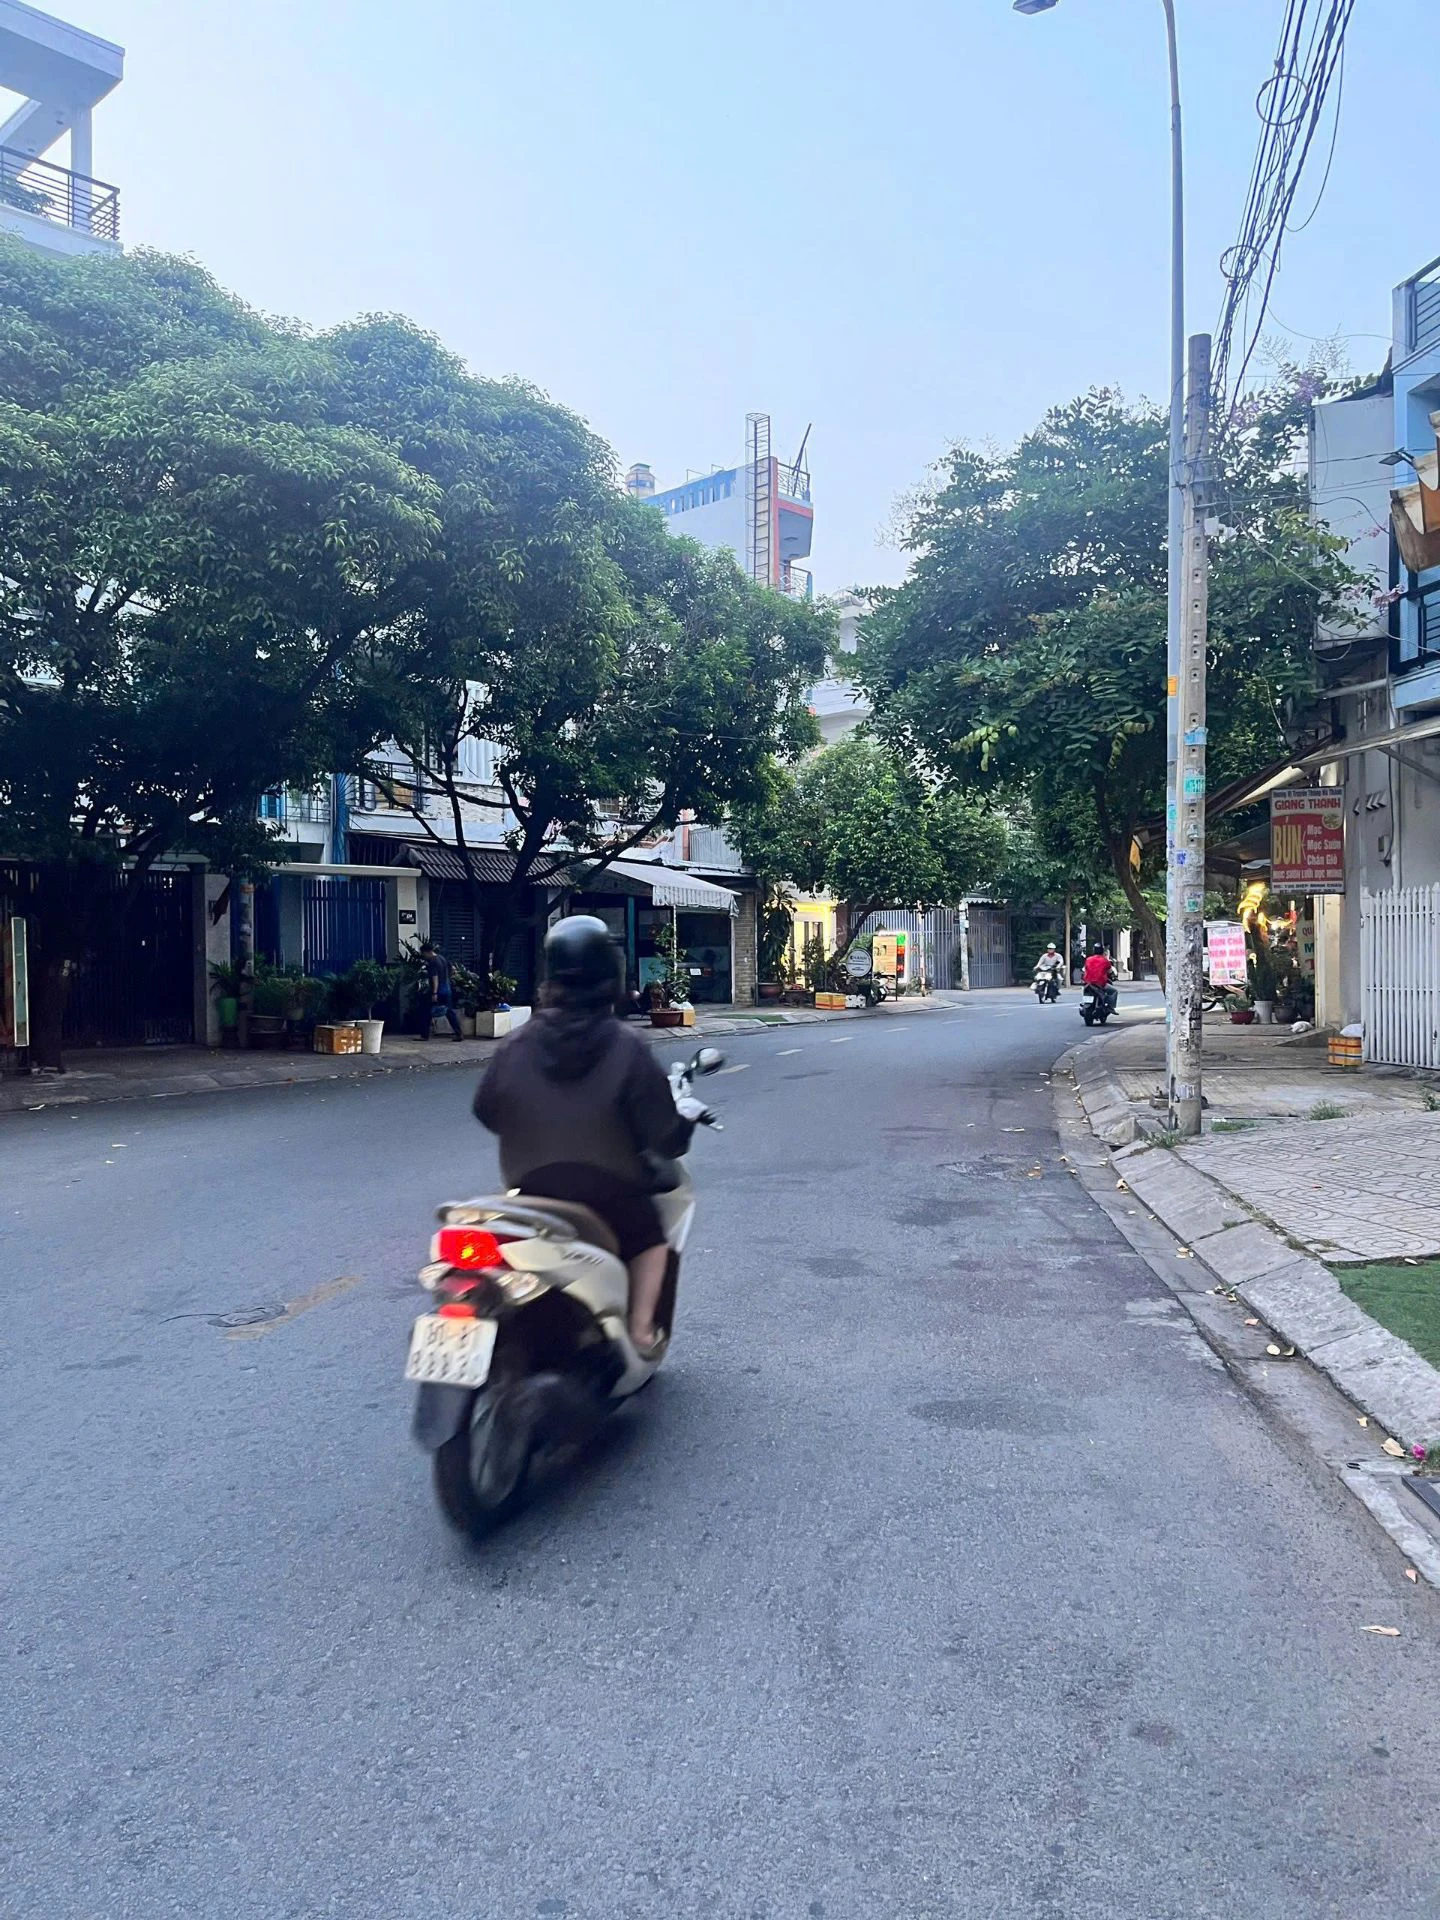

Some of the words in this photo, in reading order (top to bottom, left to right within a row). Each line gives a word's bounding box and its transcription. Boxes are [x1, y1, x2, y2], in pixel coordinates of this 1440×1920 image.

[1275, 799, 1305, 811] GIANG
[1308, 797, 1341, 809] THANH
[1307, 824, 1322, 837] Mọc
[1273, 816, 1302, 865] BÚN
[1307, 839, 1322, 852] Mọc
[1326, 853, 1338, 865] Giò
